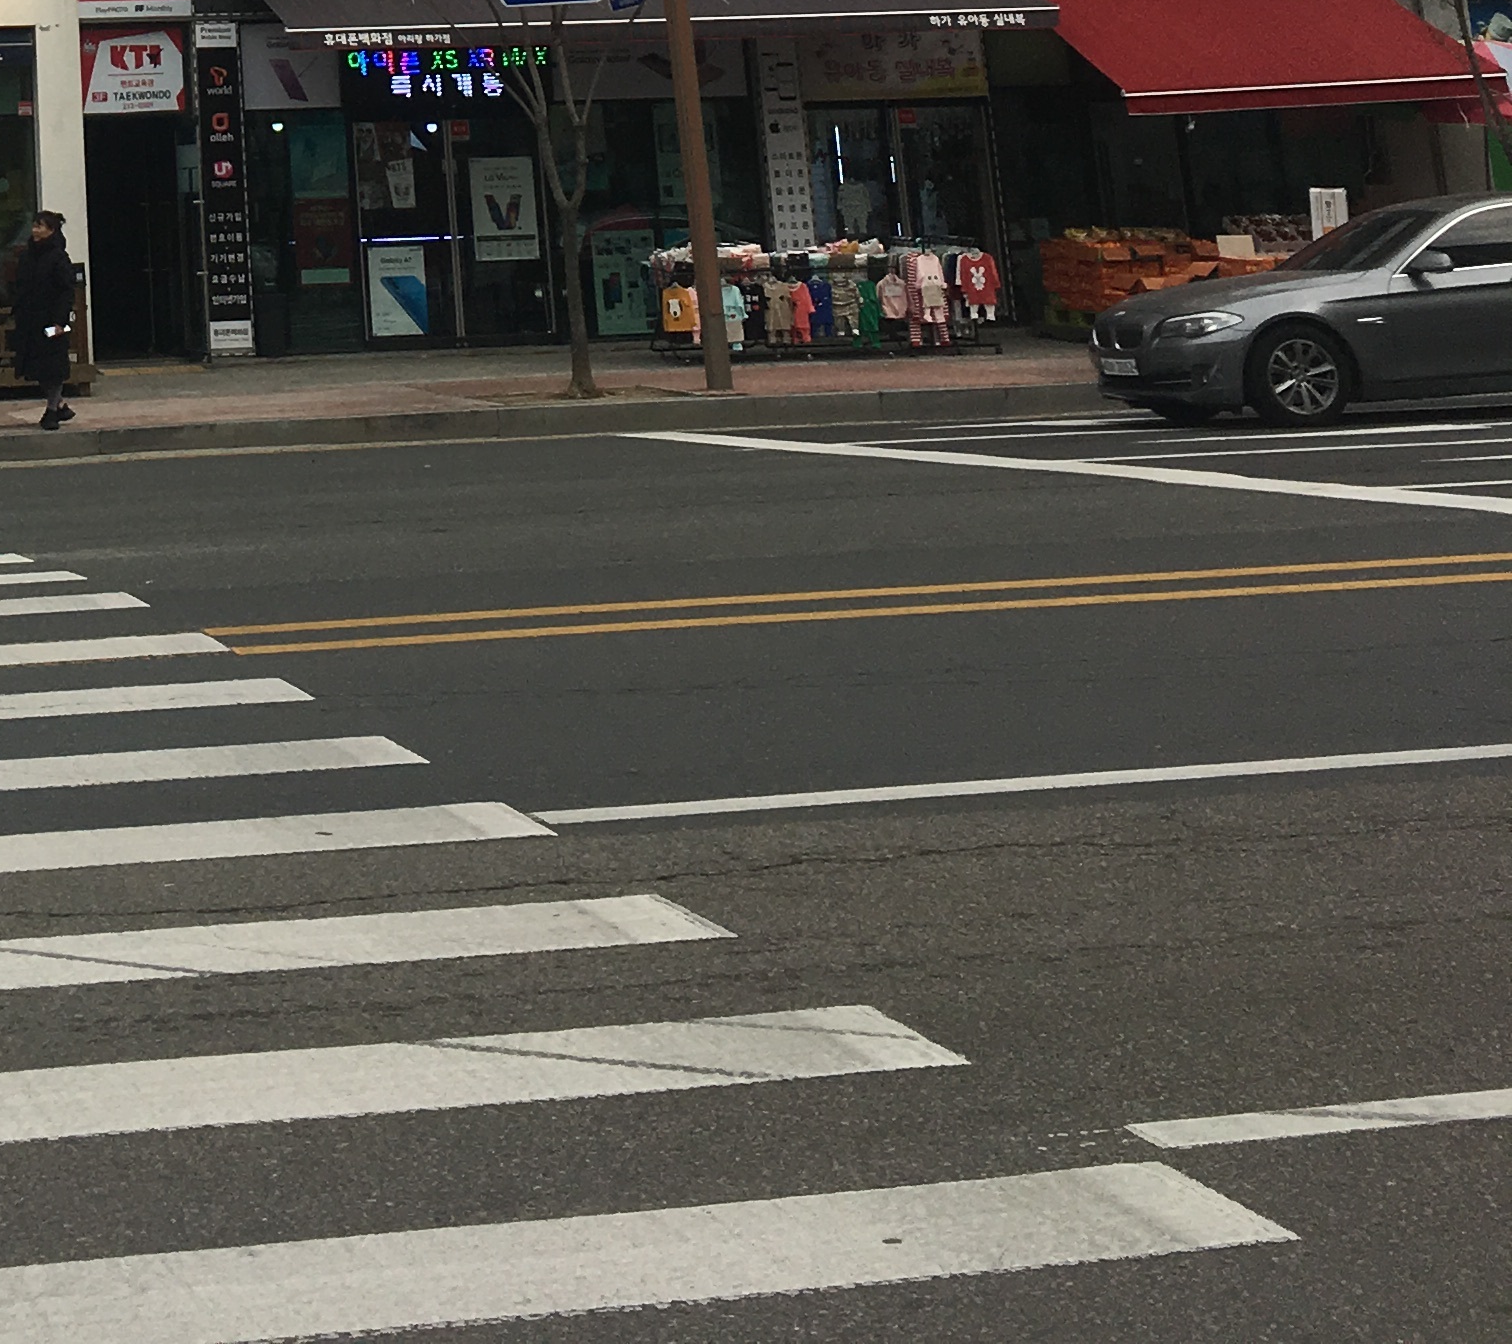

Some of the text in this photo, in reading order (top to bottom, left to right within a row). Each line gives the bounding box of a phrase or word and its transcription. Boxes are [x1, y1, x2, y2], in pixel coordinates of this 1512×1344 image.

[323, 31, 394, 46] 휴대폰백화점
[431, 49, 459, 70] XS
[113, 89, 172, 102] TAEKWONDO
[206, 85, 233, 95] world
[209, 132, 235, 143] olleh
